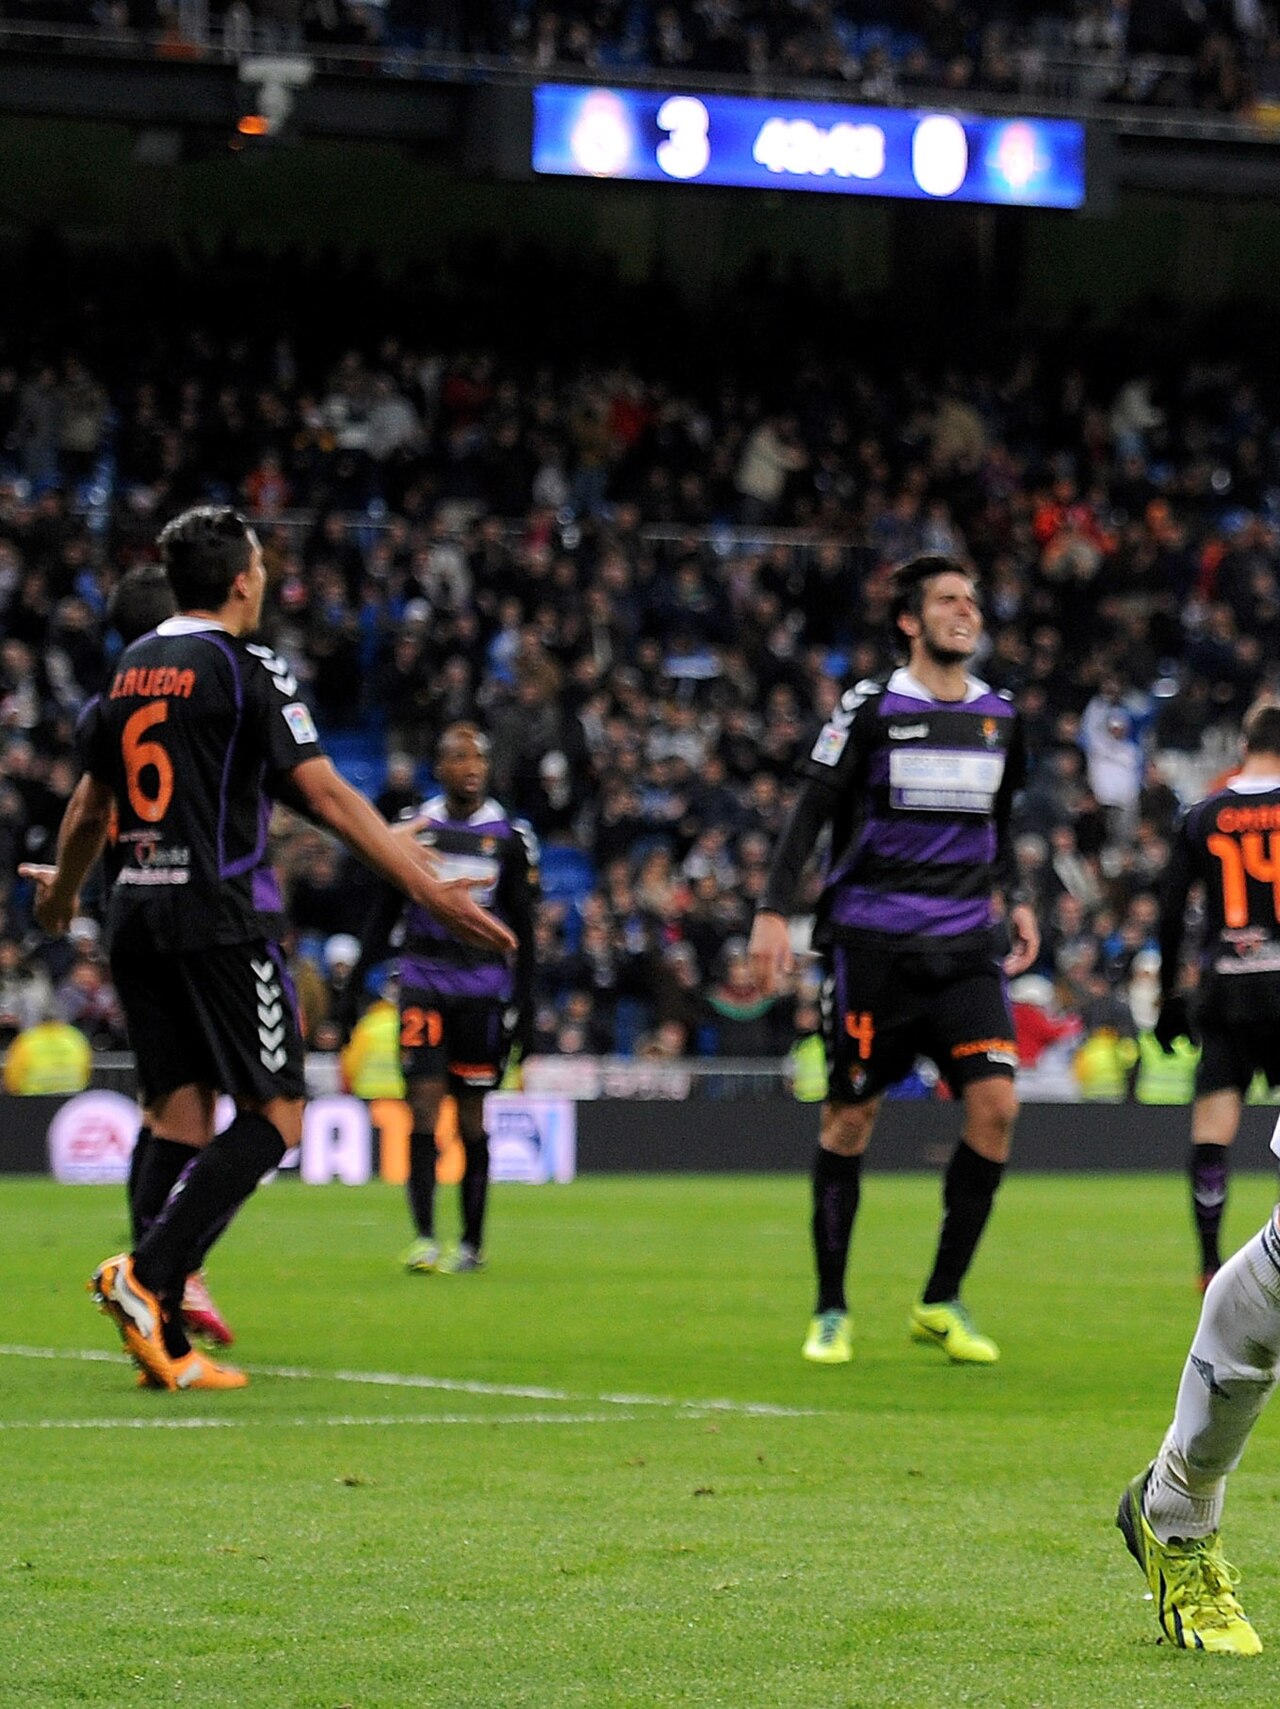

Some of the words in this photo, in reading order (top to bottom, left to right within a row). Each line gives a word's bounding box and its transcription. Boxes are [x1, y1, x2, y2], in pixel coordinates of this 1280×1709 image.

[656, 96, 710, 179] 3
[911, 114, 968, 196] 0
[121, 699, 174, 822] 6
[401, 1007, 443, 1047] 21
[846, 1012, 875, 1059] 4
